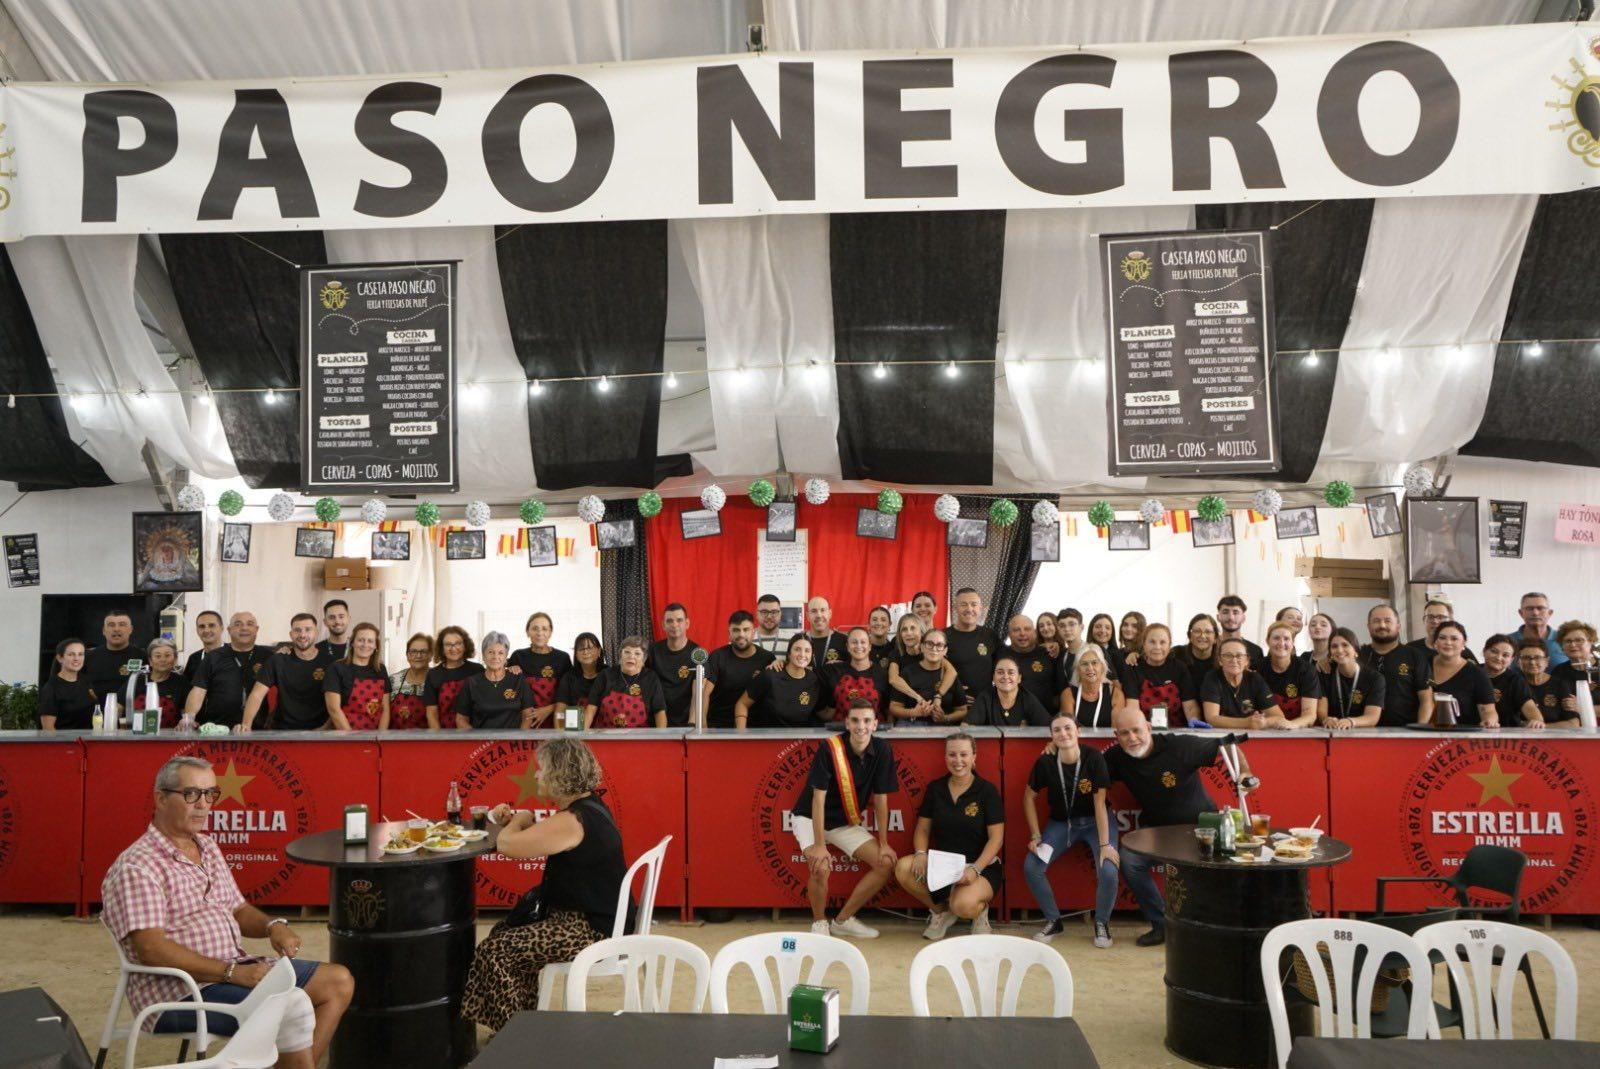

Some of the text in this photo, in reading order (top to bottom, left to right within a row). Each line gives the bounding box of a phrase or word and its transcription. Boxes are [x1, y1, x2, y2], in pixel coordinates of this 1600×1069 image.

[81, 40, 1461, 223] PASO NEGRO
[1161, 248, 1248, 266] CASETA PASO NEGRO
[1214, 268, 1222, 278] DE
[357, 279, 437, 296] CASETA PASO NEGRO
[1201, 302, 1240, 311] COCINA
[393, 331, 429, 339] COCINA
[1124, 328, 1173, 338] PLANCHA
[320, 355, 367, 364] PLANCHA
[1133, 394, 1171, 403] TOSTAS
[1206, 400, 1249, 409] POSTRES
[327, 418, 362, 427] TOSTAS
[394, 424, 432, 433] POSTRES
[1130, 440, 1258, 459] CERVEZA COPAS MOJITOS
[322, 463, 439, 480] CERVEZA COPAS MOJITOS
[1559, 508, 1575, 521] HAY
[1571, 529, 1594, 542] ROSA
[765, 745, 815, 799] CERVEZA
[1412, 744, 1467, 800] CERVEZA
[1469, 738, 1581, 800] MEDITERRÁNEA
[760, 805, 773, 834] 1876
[1408, 806, 1422, 836] 1876
[1431, 810, 1565, 836] ESTRELLA
[1573, 807, 1589, 838] 1876
[1474, 835, 1522, 848] DAMM
[226, 854, 279, 862] ORIGINAL
[761, 840, 801, 888] AUGUST
[1555, 843, 1588, 888] DAMM
[1333, 929, 1353, 942] 888
[1469, 928, 1487, 940] 106
[782, 940, 796, 951] 08
